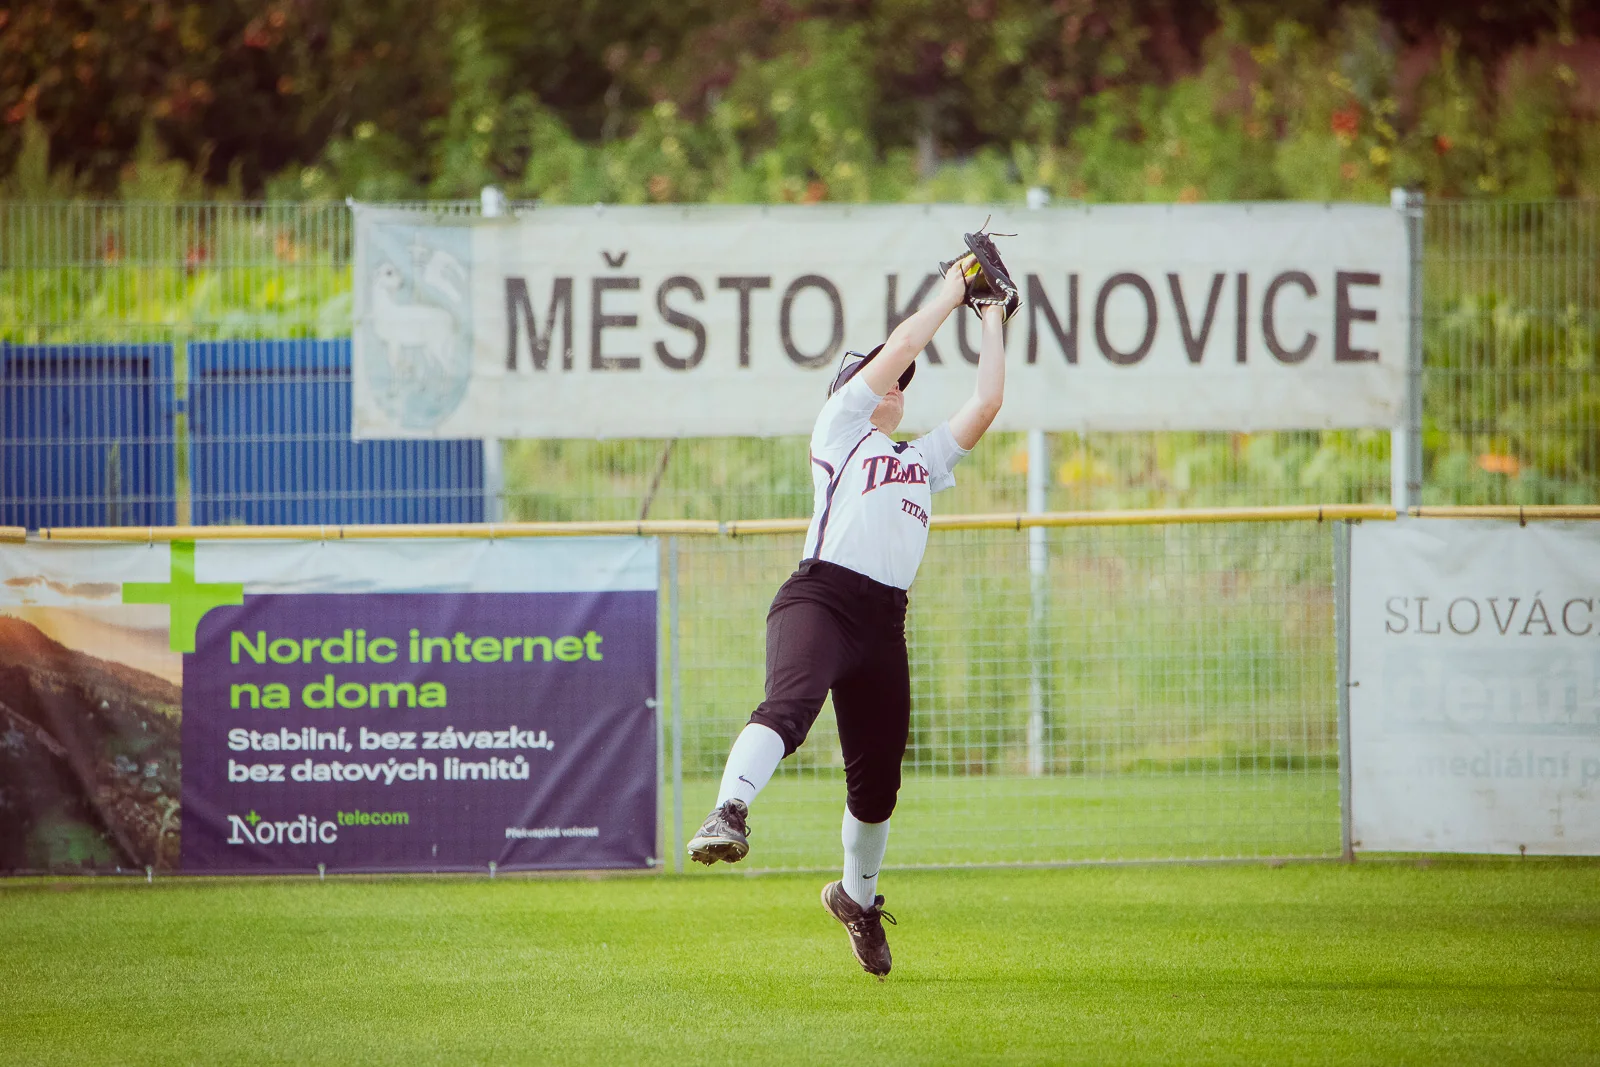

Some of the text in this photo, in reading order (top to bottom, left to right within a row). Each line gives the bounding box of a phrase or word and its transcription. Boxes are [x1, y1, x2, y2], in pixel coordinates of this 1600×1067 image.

[505, 251, 846, 372] MĚSTO
[1384, 590, 1600, 637] SLOVÁC
[230, 628, 603, 664] Nordic internet
[230, 674, 447, 709] na doma
[228, 725, 555, 753] Stabilní, bez závazku,
[228, 755, 530, 785] bez datových limitů
[227, 809, 409, 844] Nordic telecom
